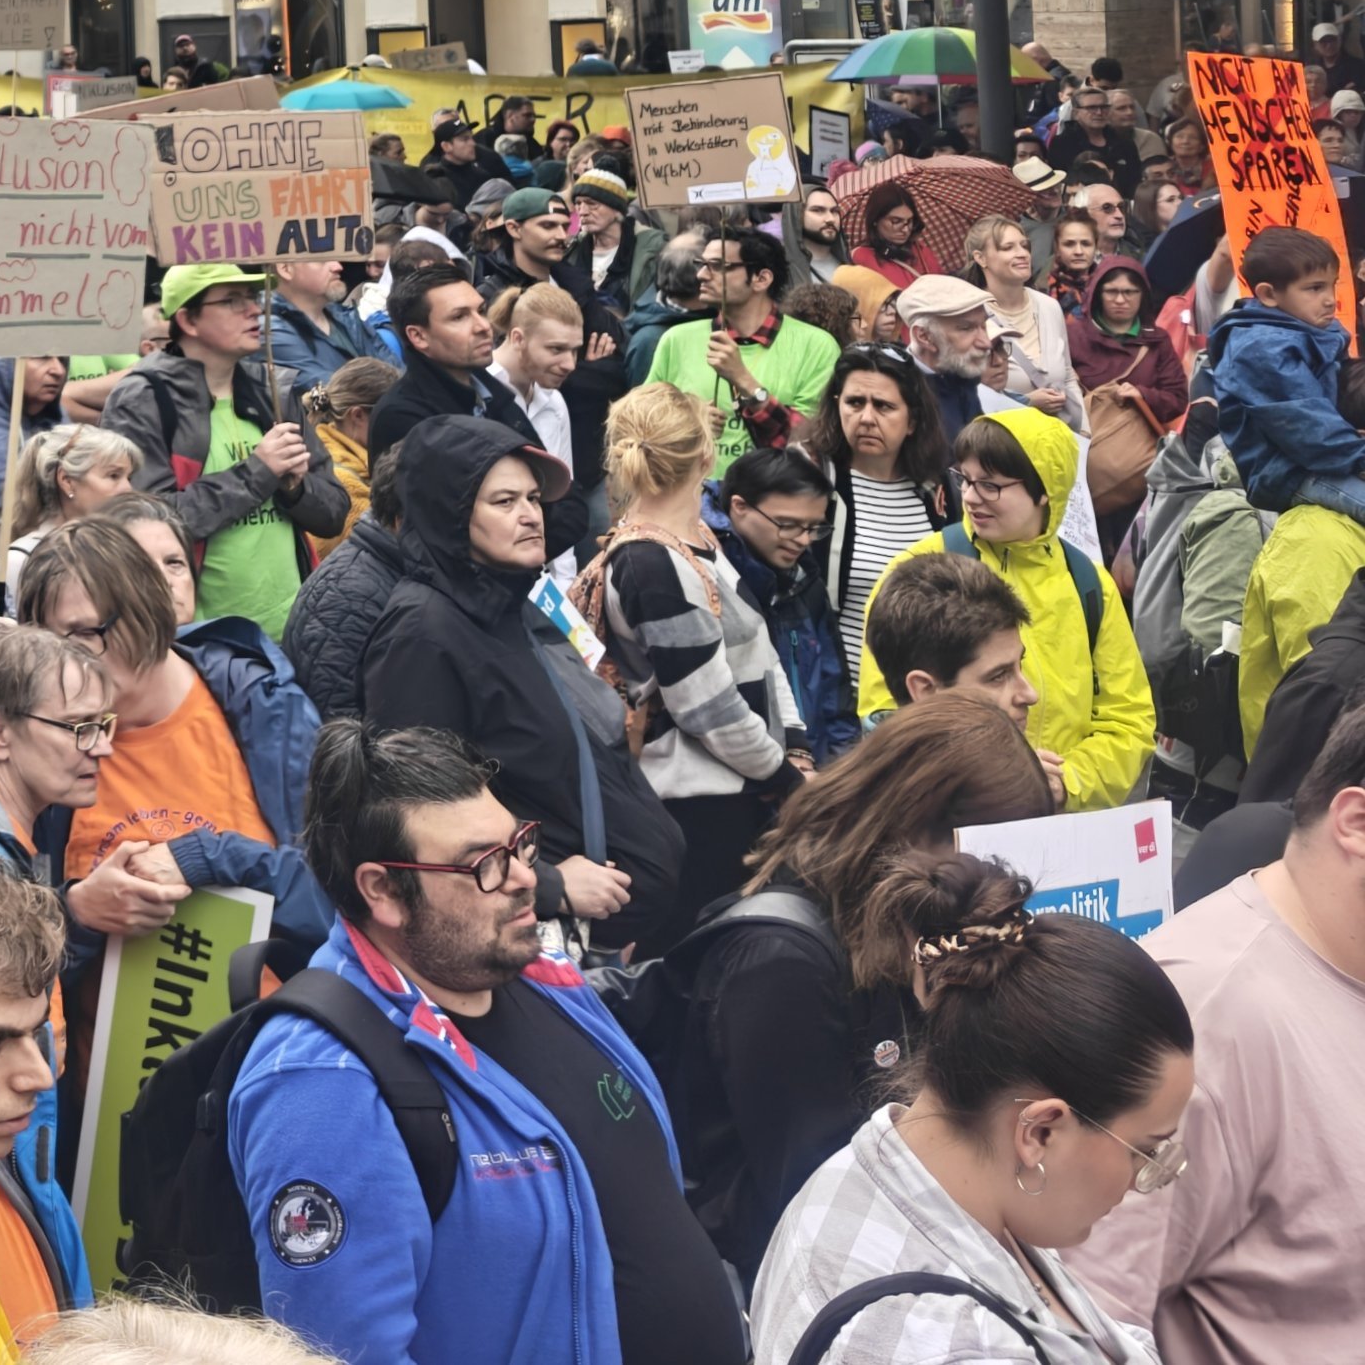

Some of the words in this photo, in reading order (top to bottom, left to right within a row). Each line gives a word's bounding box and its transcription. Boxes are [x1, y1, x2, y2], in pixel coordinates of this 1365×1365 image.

[1194, 57, 1255, 99] NICHT
[1272, 58, 1299, 97] AM
[639, 100, 699, 118] Menschen
[642, 124, 664, 135] mit
[671, 115, 748, 133] Behinderung
[1199, 98, 1316, 145] MENSCHEN
[181, 120, 324, 173] OHNE
[664, 137, 739, 157] Werkstätten
[173, 178, 260, 223] UNS
[268, 167, 370, 218] FÄHRT
[20, 208, 96, 248] nicht
[103, 218, 148, 249] vom
[172, 220, 265, 264] KEIN
[275, 215, 375, 256] AUTO
